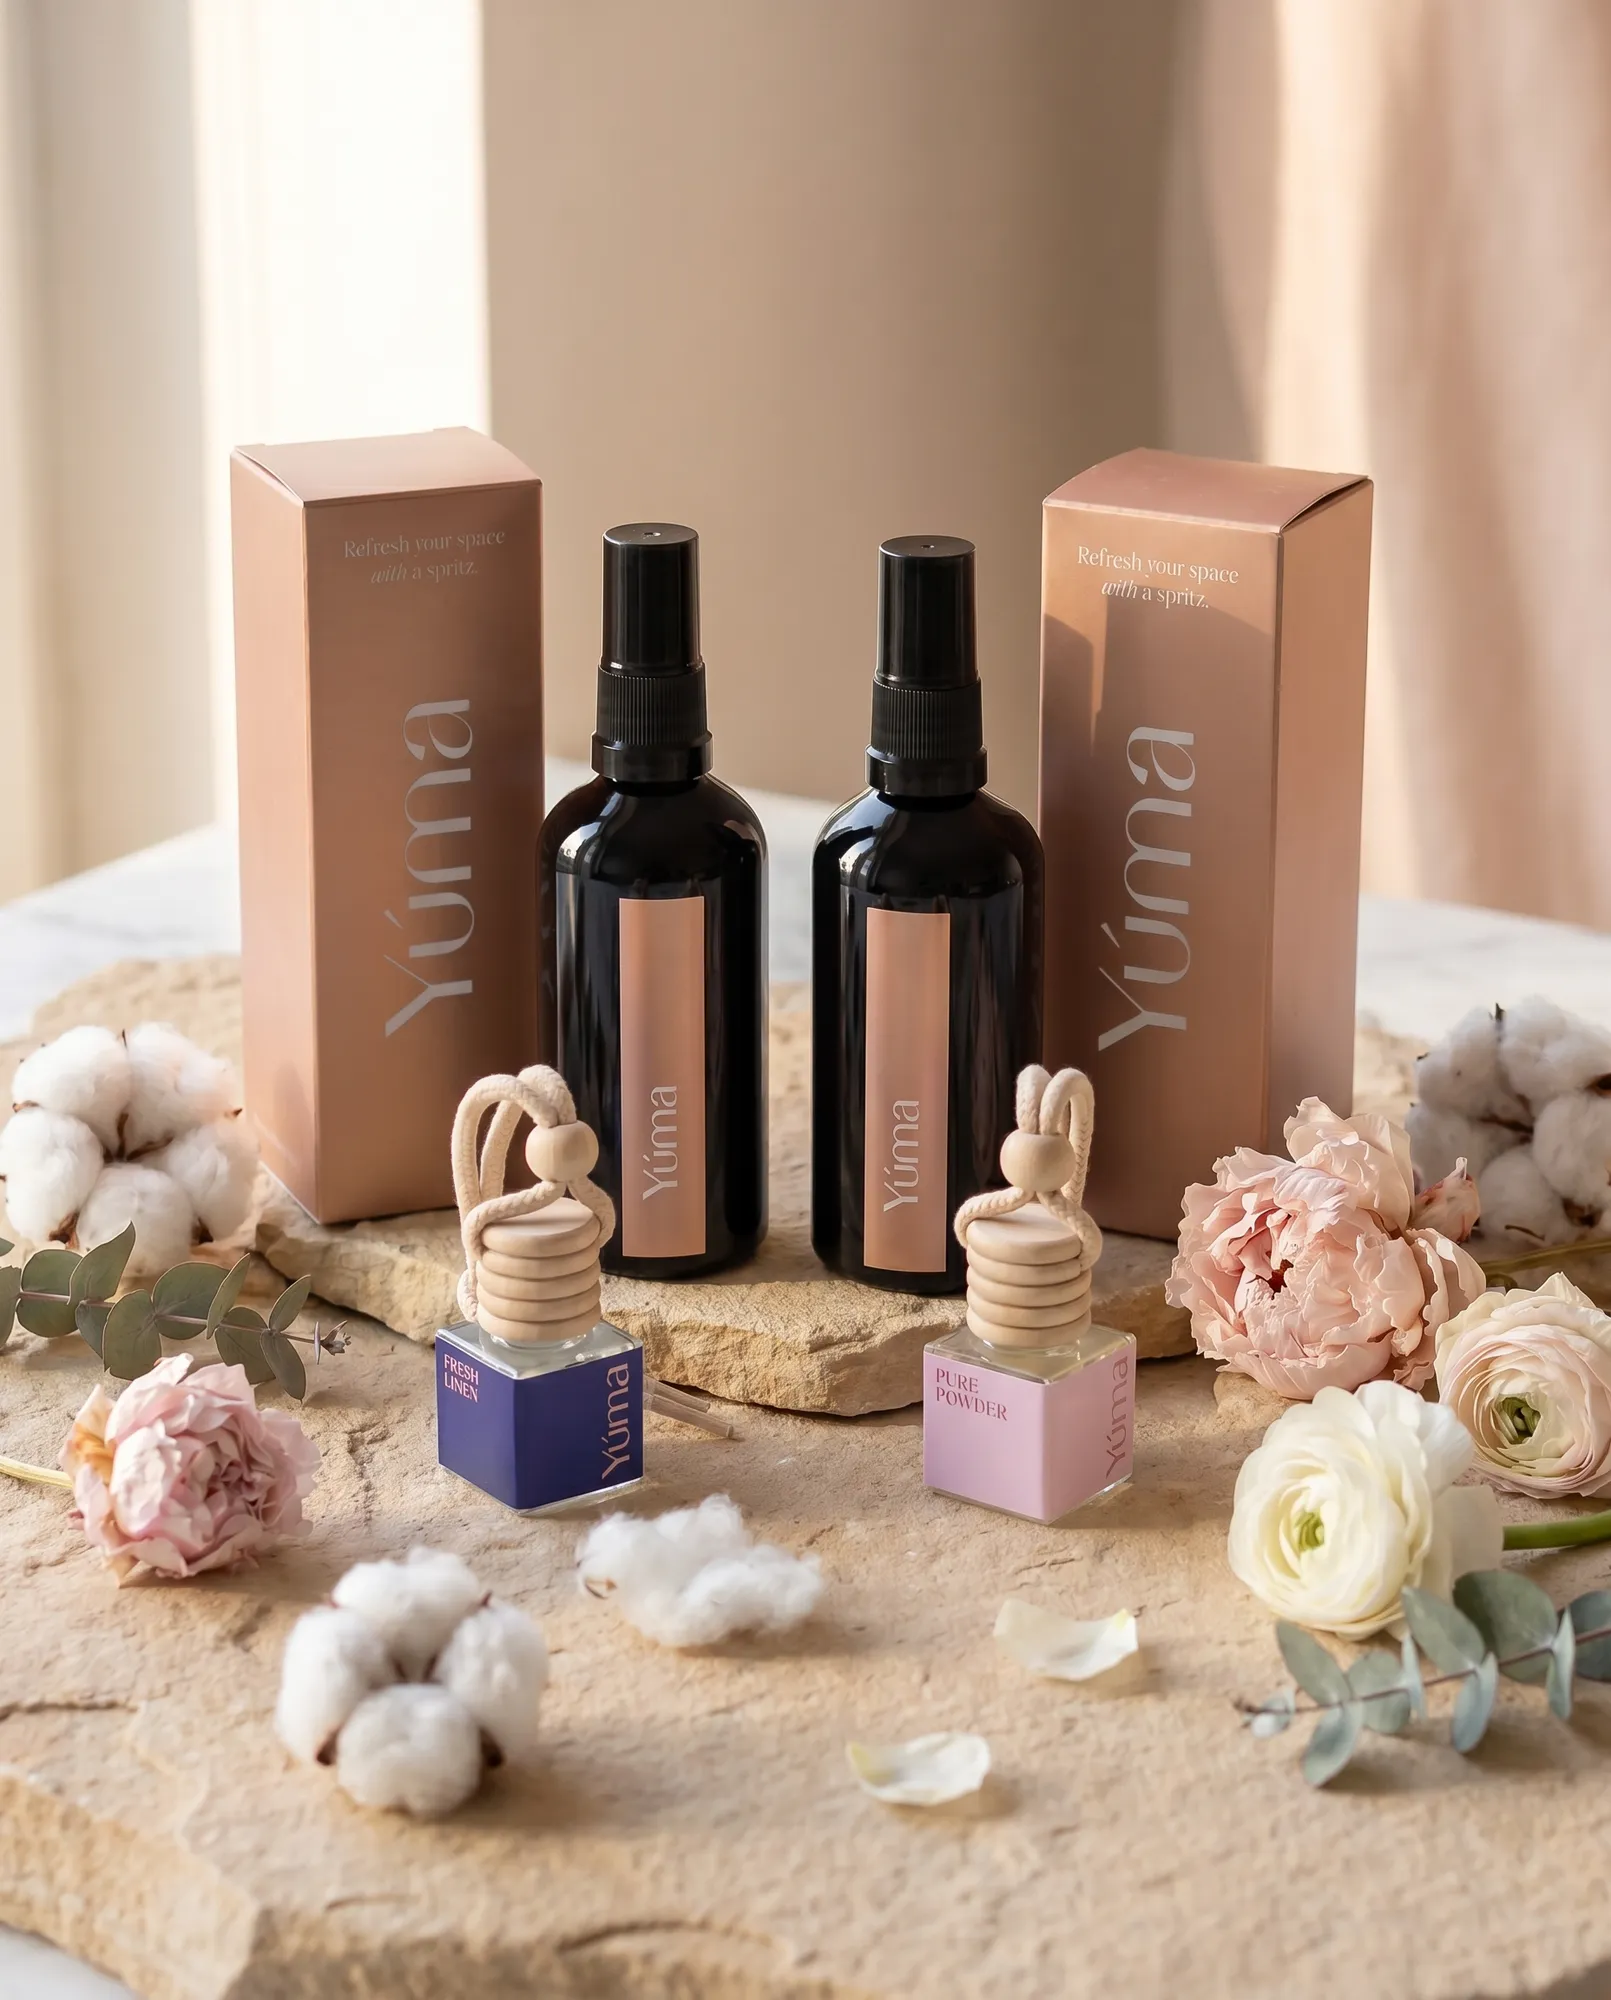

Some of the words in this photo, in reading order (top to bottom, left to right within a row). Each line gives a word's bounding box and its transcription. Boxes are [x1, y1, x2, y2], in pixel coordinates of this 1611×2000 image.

[344, 535, 409, 558] Refresh
[414, 536, 452, 557] your
[456, 531, 505, 553] space
[371, 562, 407, 584] with
[412, 566, 422, 580] a
[427, 559, 478, 583] spritz.
[1077, 545, 1142, 571] Refresh
[1145, 559, 1185, 578] your
[1189, 564, 1239, 585] space
[1101, 579, 1138, 599] with
[1142, 587, 1152, 601] a
[1157, 588, 1209, 609] spritz.
[383, 699, 475, 1038] Yúma
[1098, 726, 1196, 1052] Yúma
[642, 1085, 678, 1201] Yúma
[883, 1100, 920, 1213] Yúma
[444, 1353, 479, 1385] FRESH
[444, 1372, 478, 1403] LINEN
[936, 1367, 979, 1394] PURE
[601, 1363, 631, 1480] Yúma
[936, 1386, 1008, 1421] POWDER
[1105, 1356, 1128, 1479] Yúma
